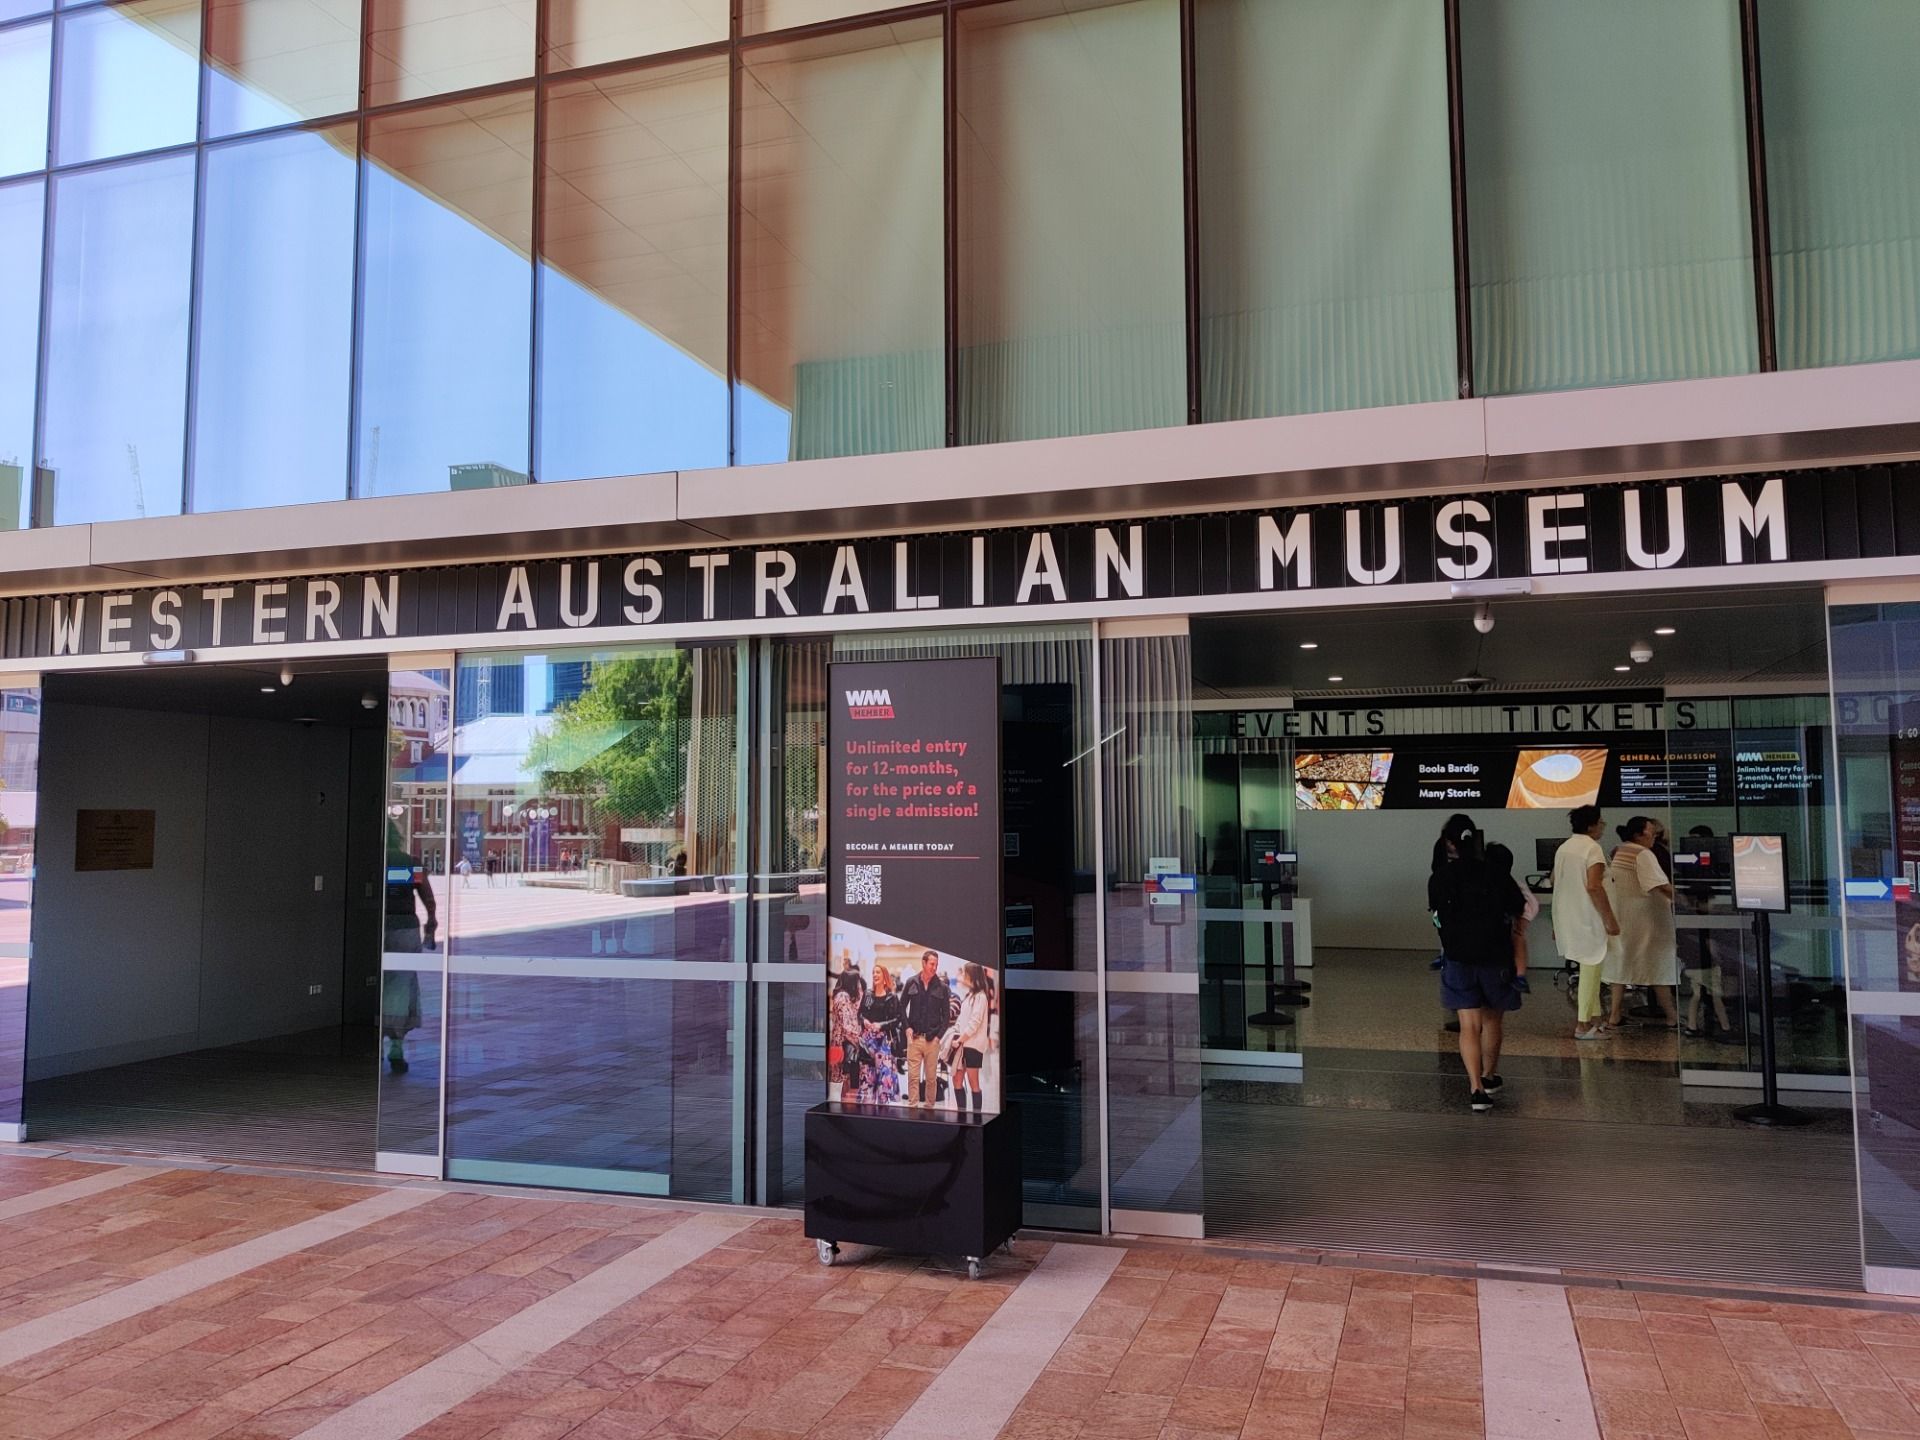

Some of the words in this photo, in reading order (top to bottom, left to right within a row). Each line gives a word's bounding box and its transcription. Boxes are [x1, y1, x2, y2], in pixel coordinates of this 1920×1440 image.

[53, 575, 399, 656] WESTERN
[495, 525, 1143, 630] AUSTRALIAN
[1258, 478, 1789, 590] MUSEUM
[845, 689, 892, 707] WAM
[853, 708, 890, 717] MEMBER
[1234, 710, 1385, 737] EVENTS
[1502, 701, 1698, 732] TICKETS
[846, 739, 921, 755] Unlimited
[925, 740, 968, 757] entry
[846, 761, 869, 776] for
[872, 760, 959, 777] 12-months,
[1418, 763, 1446, 774] Boola
[1447, 763, 1480, 776] Bardip
[1789, 773, 1802, 781] the
[846, 782, 869, 797] for
[873, 782, 898, 797] the
[902, 781, 942, 800] price
[946, 780, 965, 796] of
[967, 784, 977, 796] a
[1418, 789, 1445, 801] Many
[1446, 788, 1482, 799] Stories
[1750, 782, 1772, 791] single
[846, 803, 891, 821] single
[895, 802, 979, 817] admission!
[845, 843, 879, 852] BECOME
[881, 843, 888, 851] A
[889, 843, 925, 852] MEMBER
[926, 843, 955, 851] TODAY
